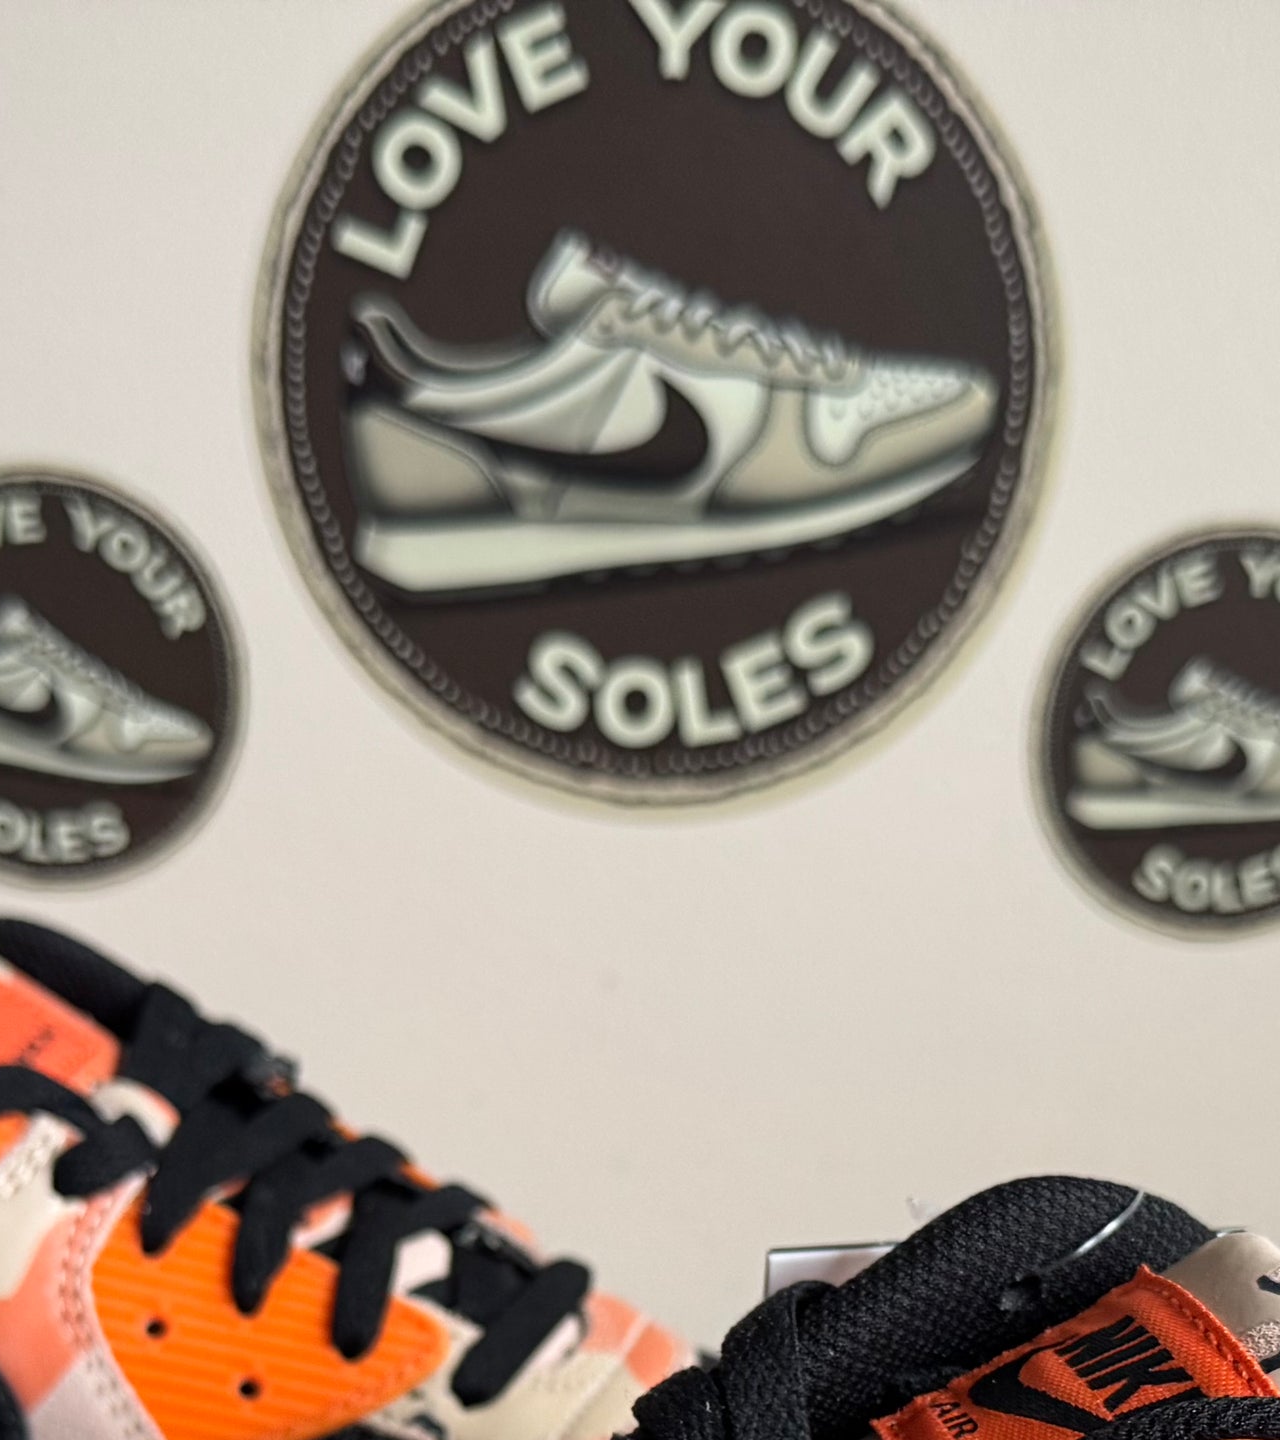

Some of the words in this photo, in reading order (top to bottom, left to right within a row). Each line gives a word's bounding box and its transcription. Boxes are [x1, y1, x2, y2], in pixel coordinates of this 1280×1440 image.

[332, 5, 590, 281] LOVE
[628, 0, 936, 210] YOUR
[61, 495, 206, 640] YOUR
[1079, 552, 1223, 681] LOVE
[516, 594, 874, 748] SOLES
[929, 1401, 979, 1440] AIR
